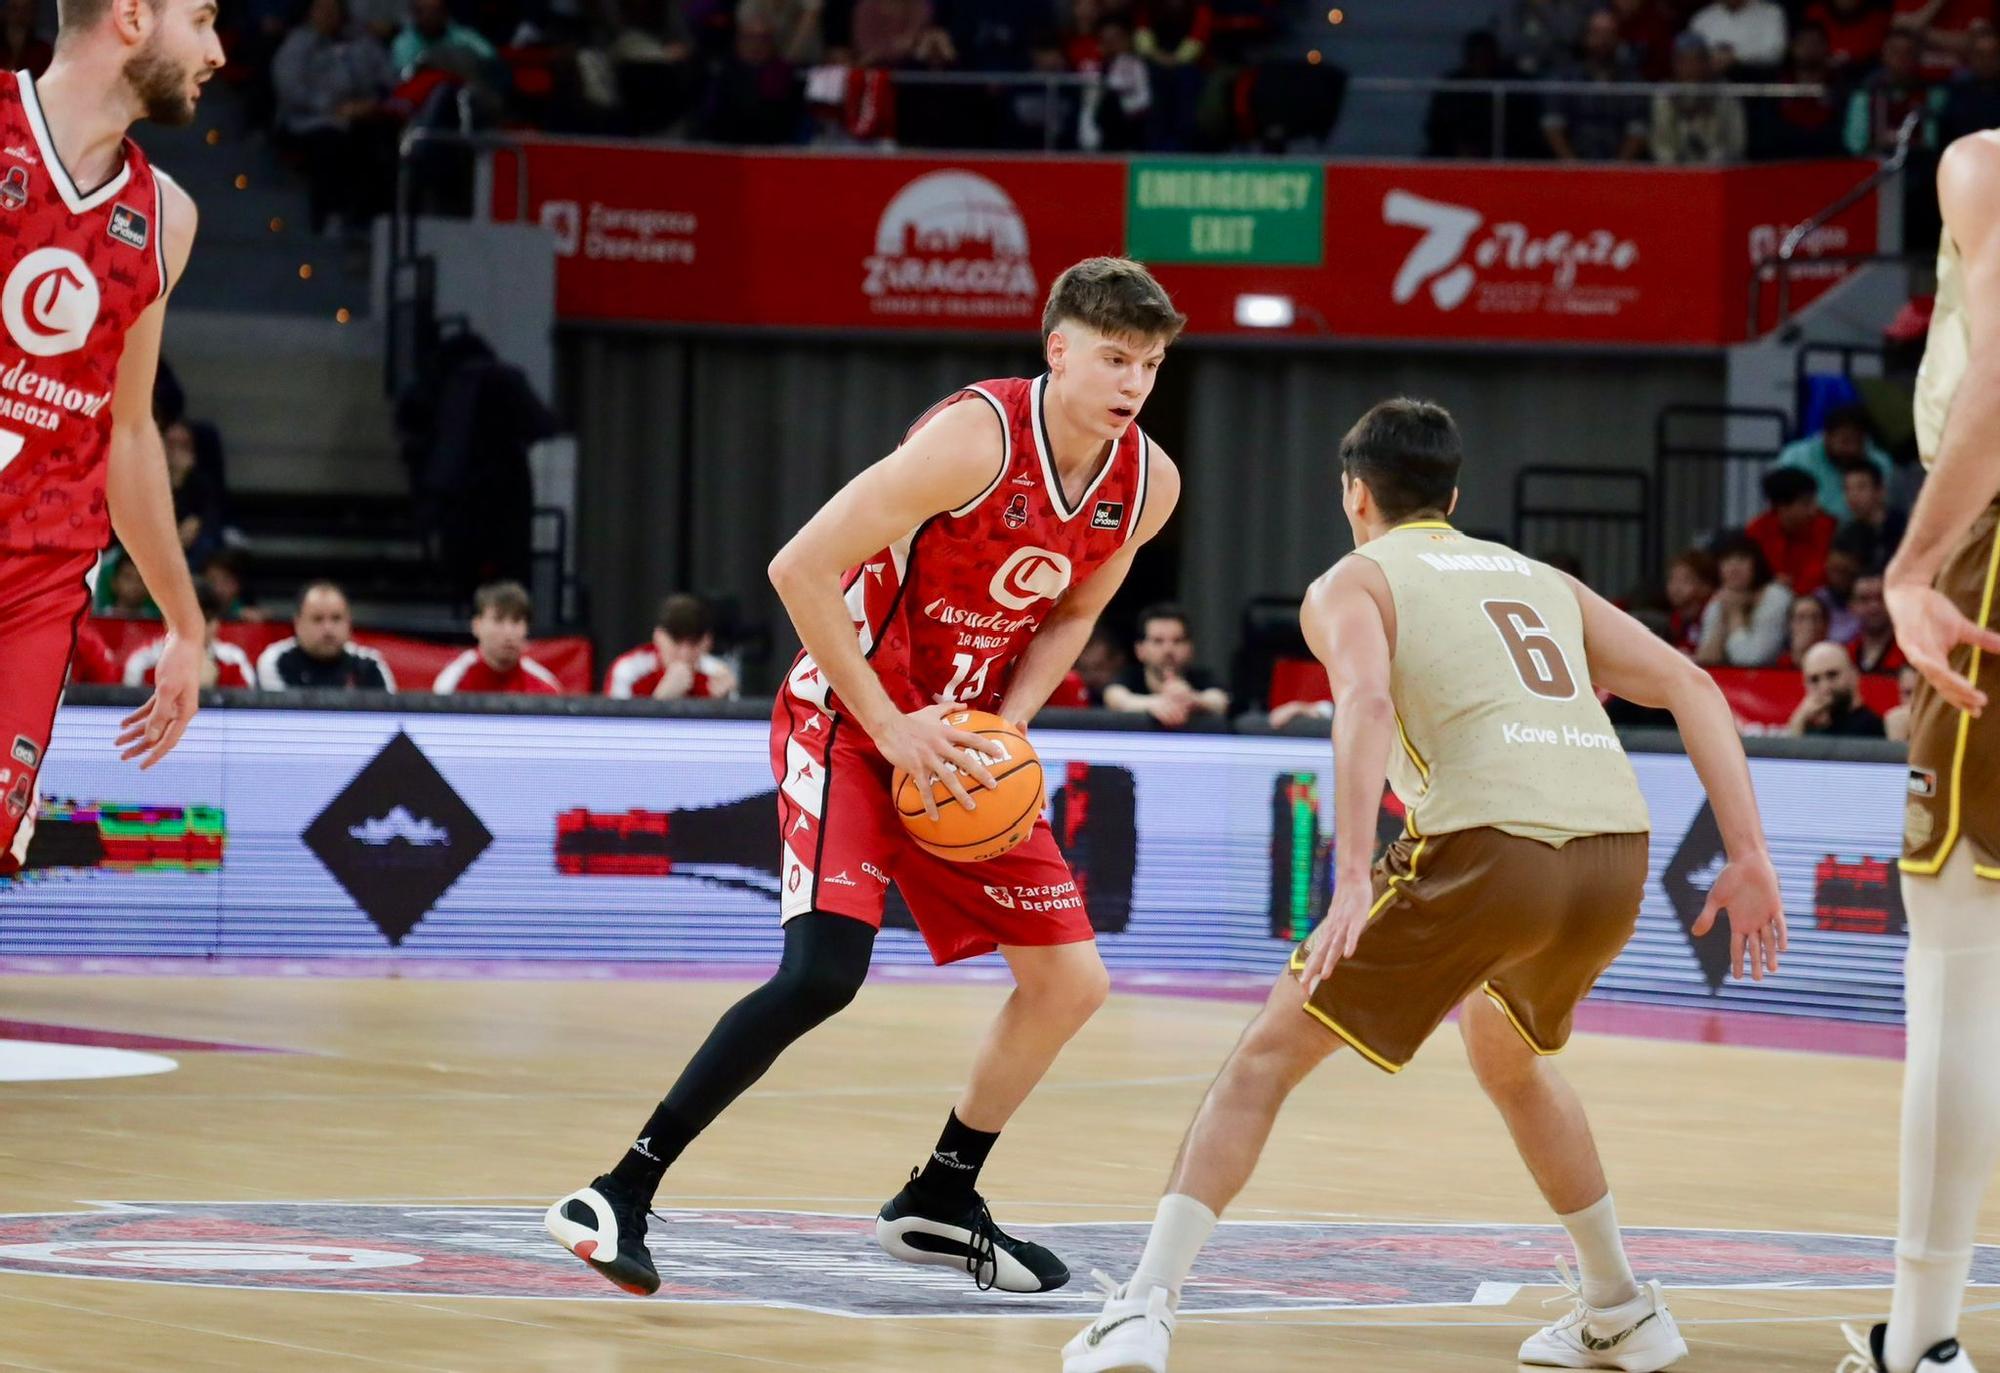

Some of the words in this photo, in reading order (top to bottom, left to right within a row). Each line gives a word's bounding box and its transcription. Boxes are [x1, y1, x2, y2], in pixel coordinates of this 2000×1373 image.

[1137, 170, 1312, 212] EMERGENCY
[1191, 215, 1256, 254] EXIT
[1480, 598, 1579, 701] 6
[1502, 722, 1557, 745] Kave
[1014, 881, 1075, 898] Zaragoza
[1021, 896, 1082, 912] DEPORTE
